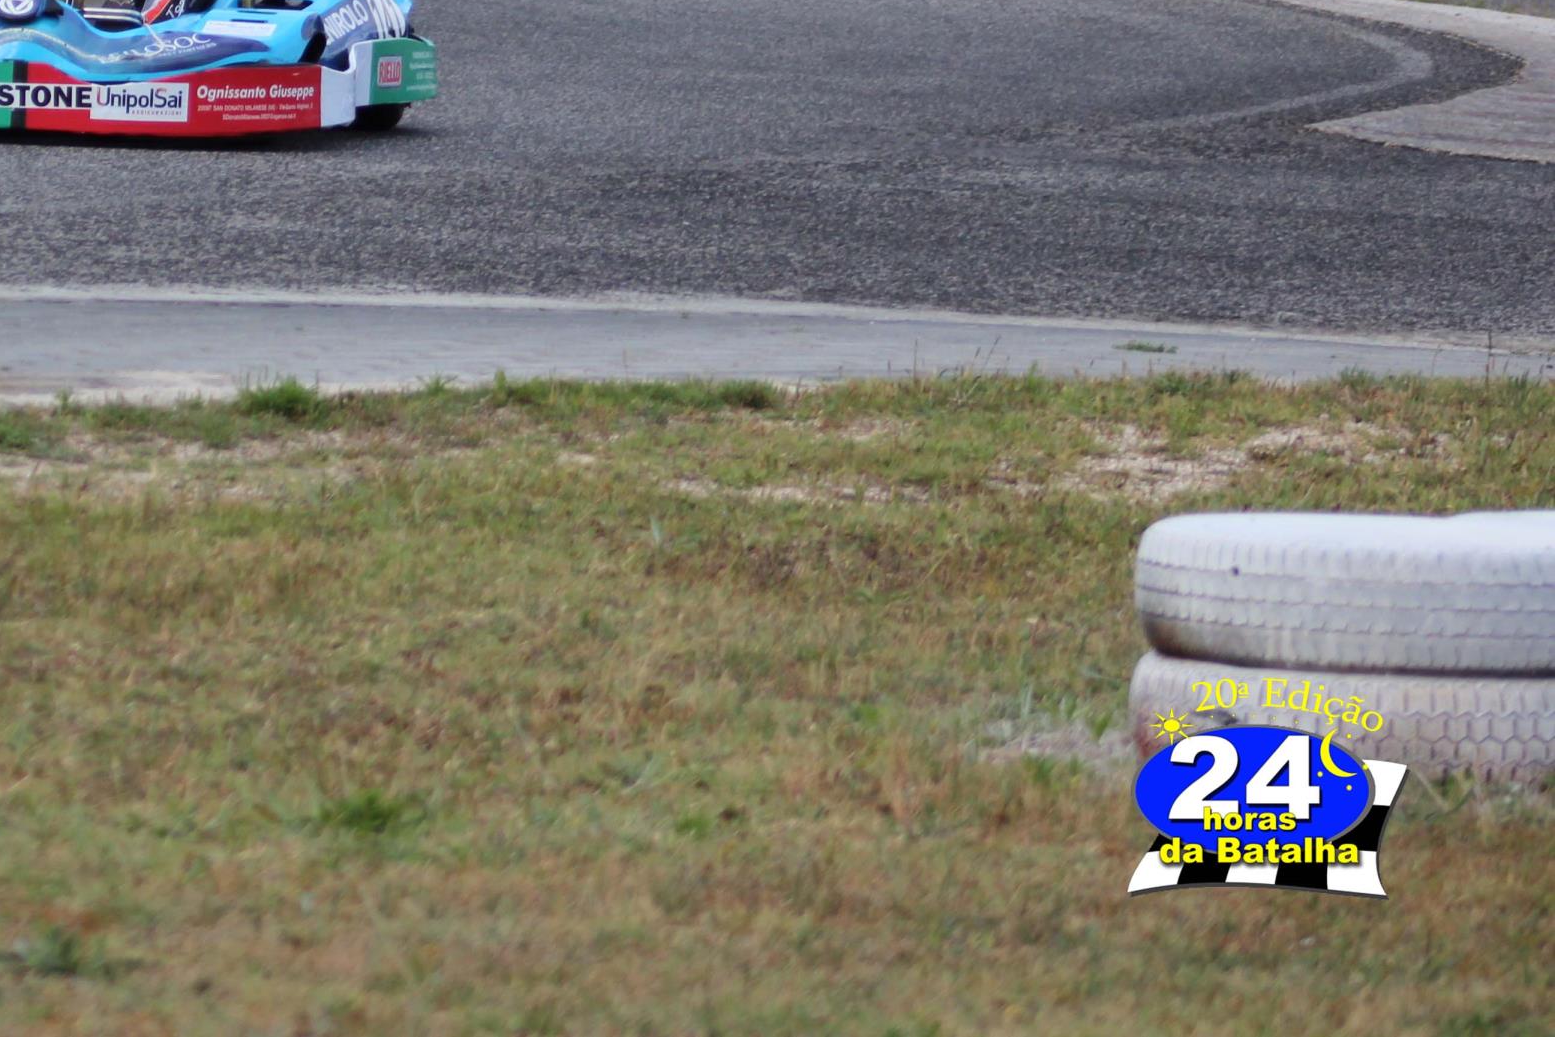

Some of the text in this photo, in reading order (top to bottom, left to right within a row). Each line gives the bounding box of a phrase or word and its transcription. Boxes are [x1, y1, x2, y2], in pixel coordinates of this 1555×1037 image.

[97, 86, 183, 114] UnipolSai
[197, 84, 315, 102] Ognissanto Giuseppe
